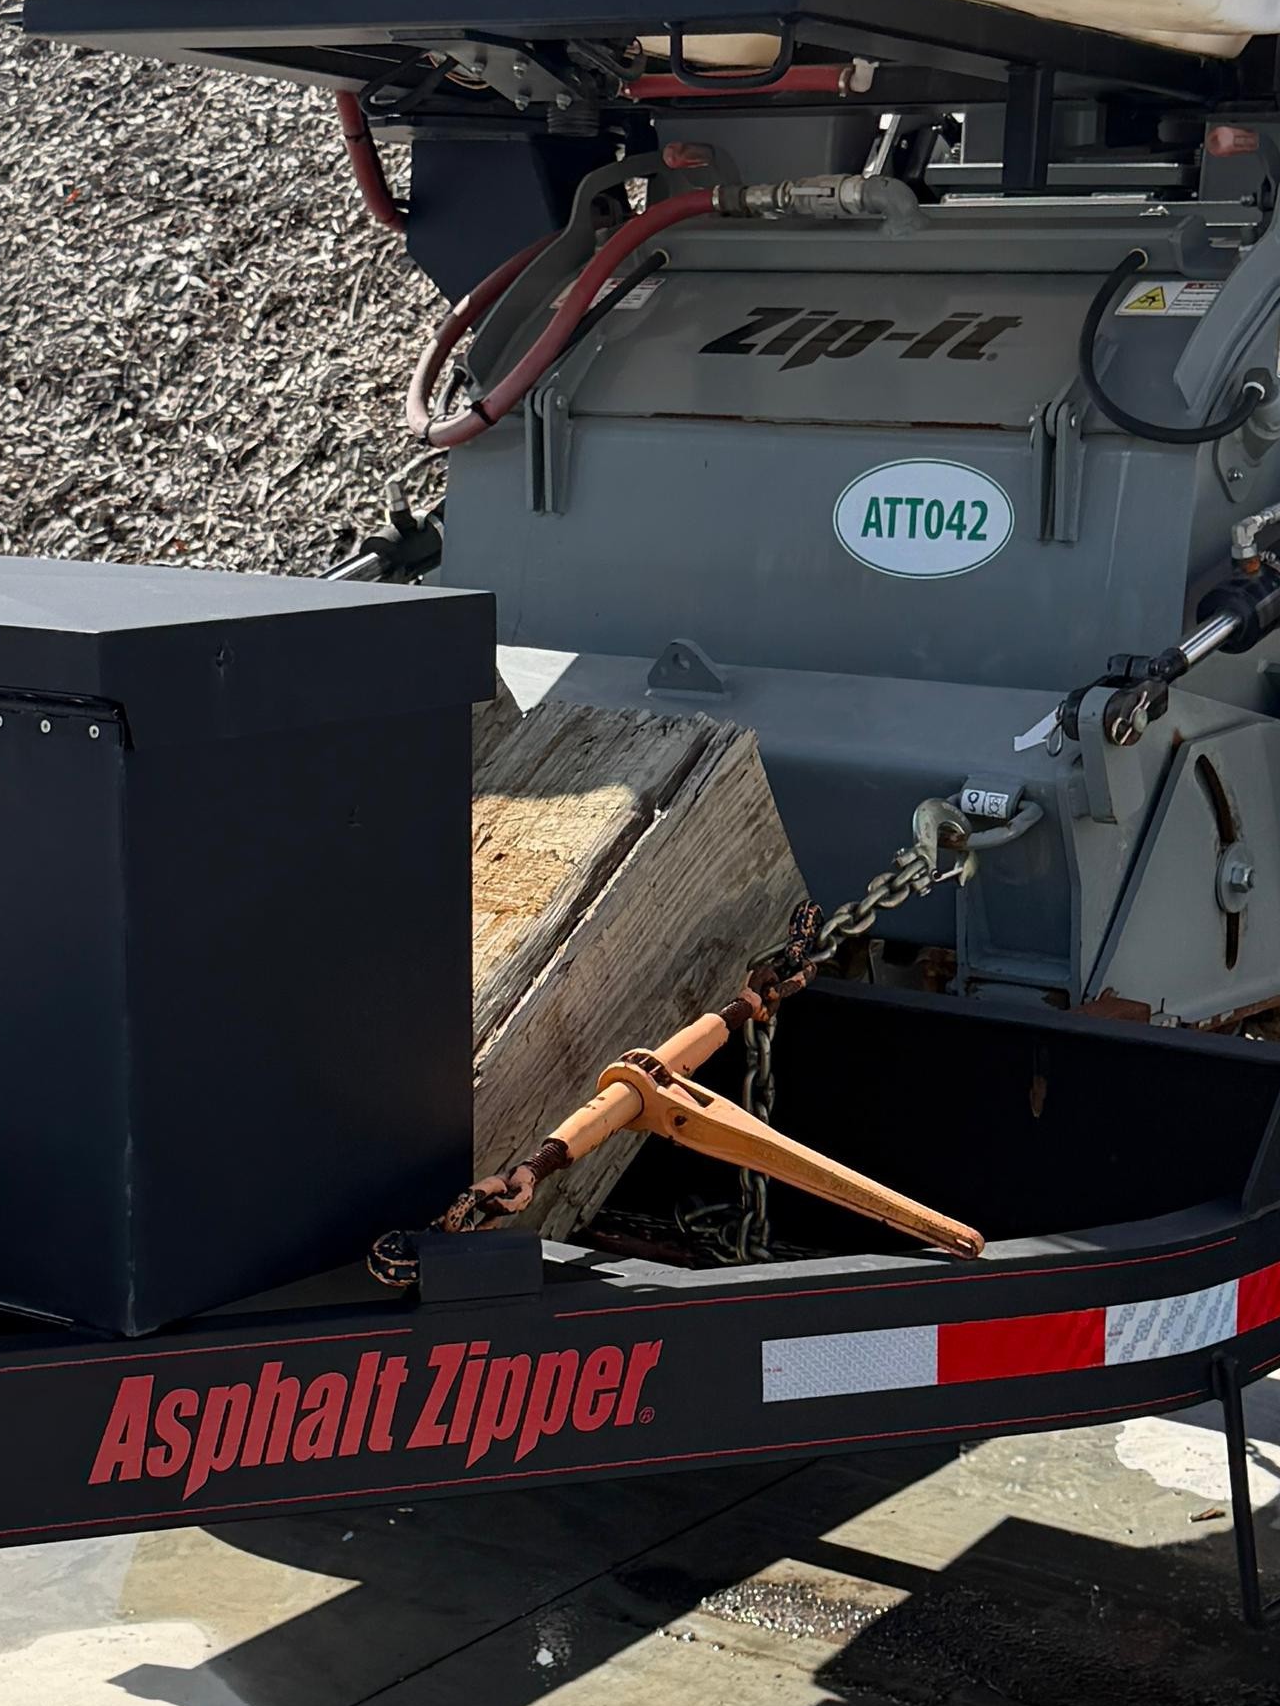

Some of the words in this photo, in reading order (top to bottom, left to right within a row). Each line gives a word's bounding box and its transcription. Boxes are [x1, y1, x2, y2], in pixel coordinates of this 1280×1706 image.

[699, 306, 1023, 370] Zip-it
[860, 495, 989, 543] ATT042
[89, 1350, 408, 1500] Asphalt
[406, 1338, 663, 1468] Zipper
